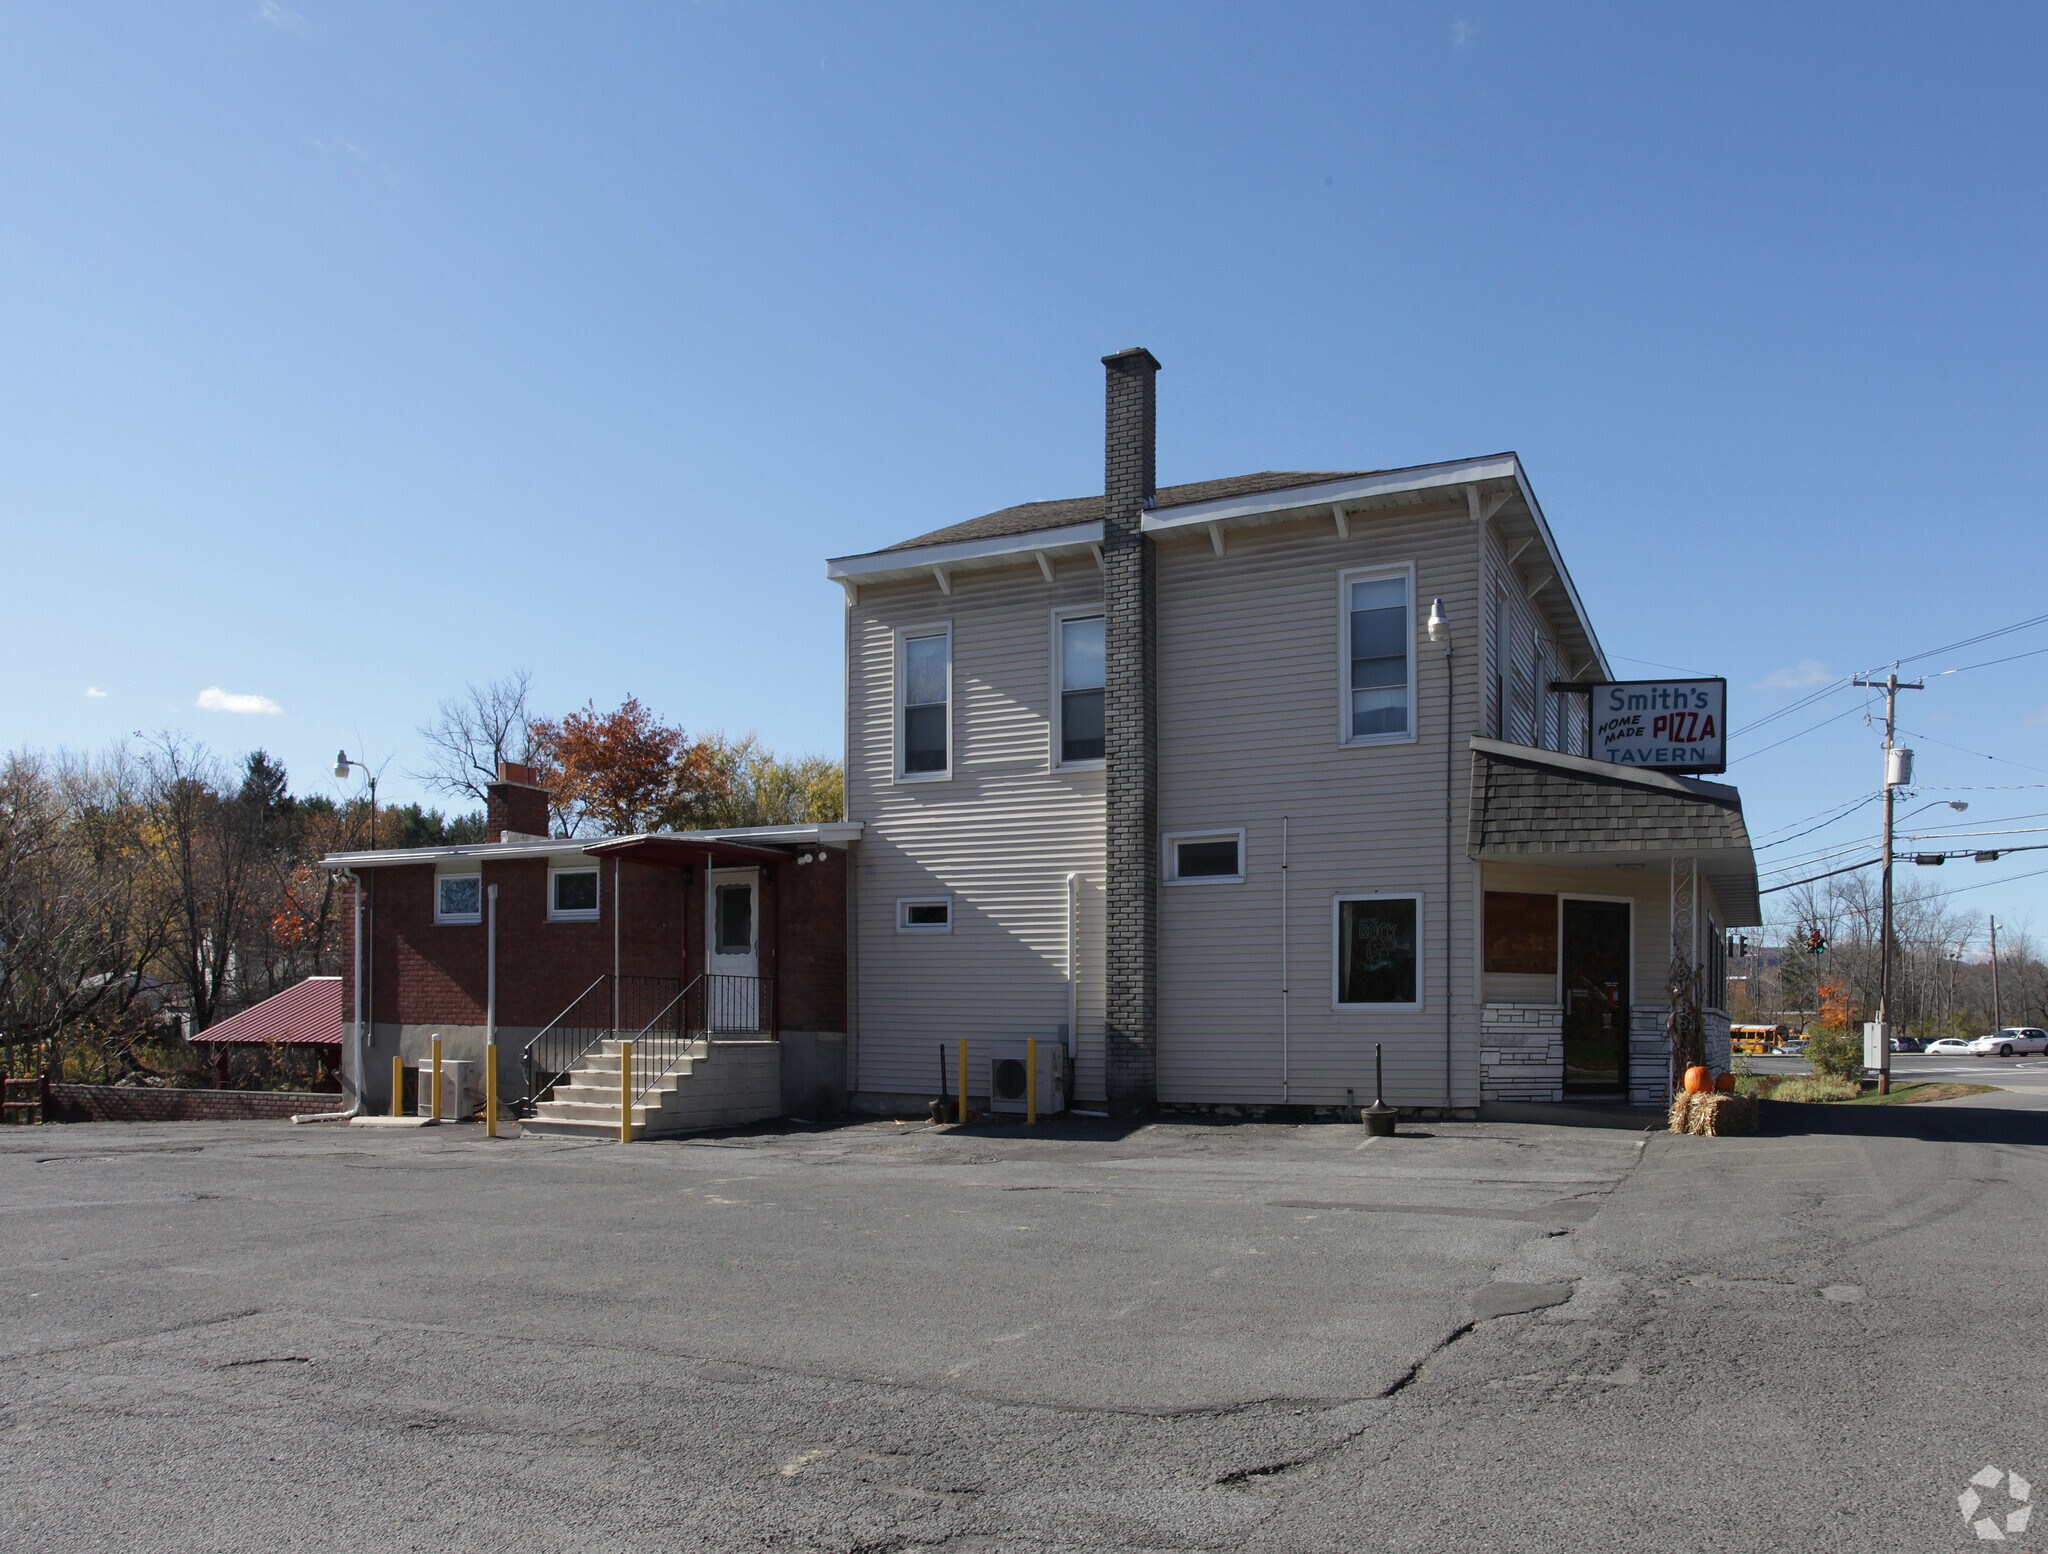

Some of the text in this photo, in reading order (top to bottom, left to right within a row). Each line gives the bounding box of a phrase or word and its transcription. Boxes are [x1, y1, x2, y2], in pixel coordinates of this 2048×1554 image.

[1609, 687, 1708, 711] Smith's
[1598, 715, 1642, 736] HOME
[1605, 726, 1645, 745] MADE
[1653, 712, 1716, 743] PIZZA
[1607, 748, 1706, 763] TAVERN
[1359, 922, 1398, 945] ROCK
